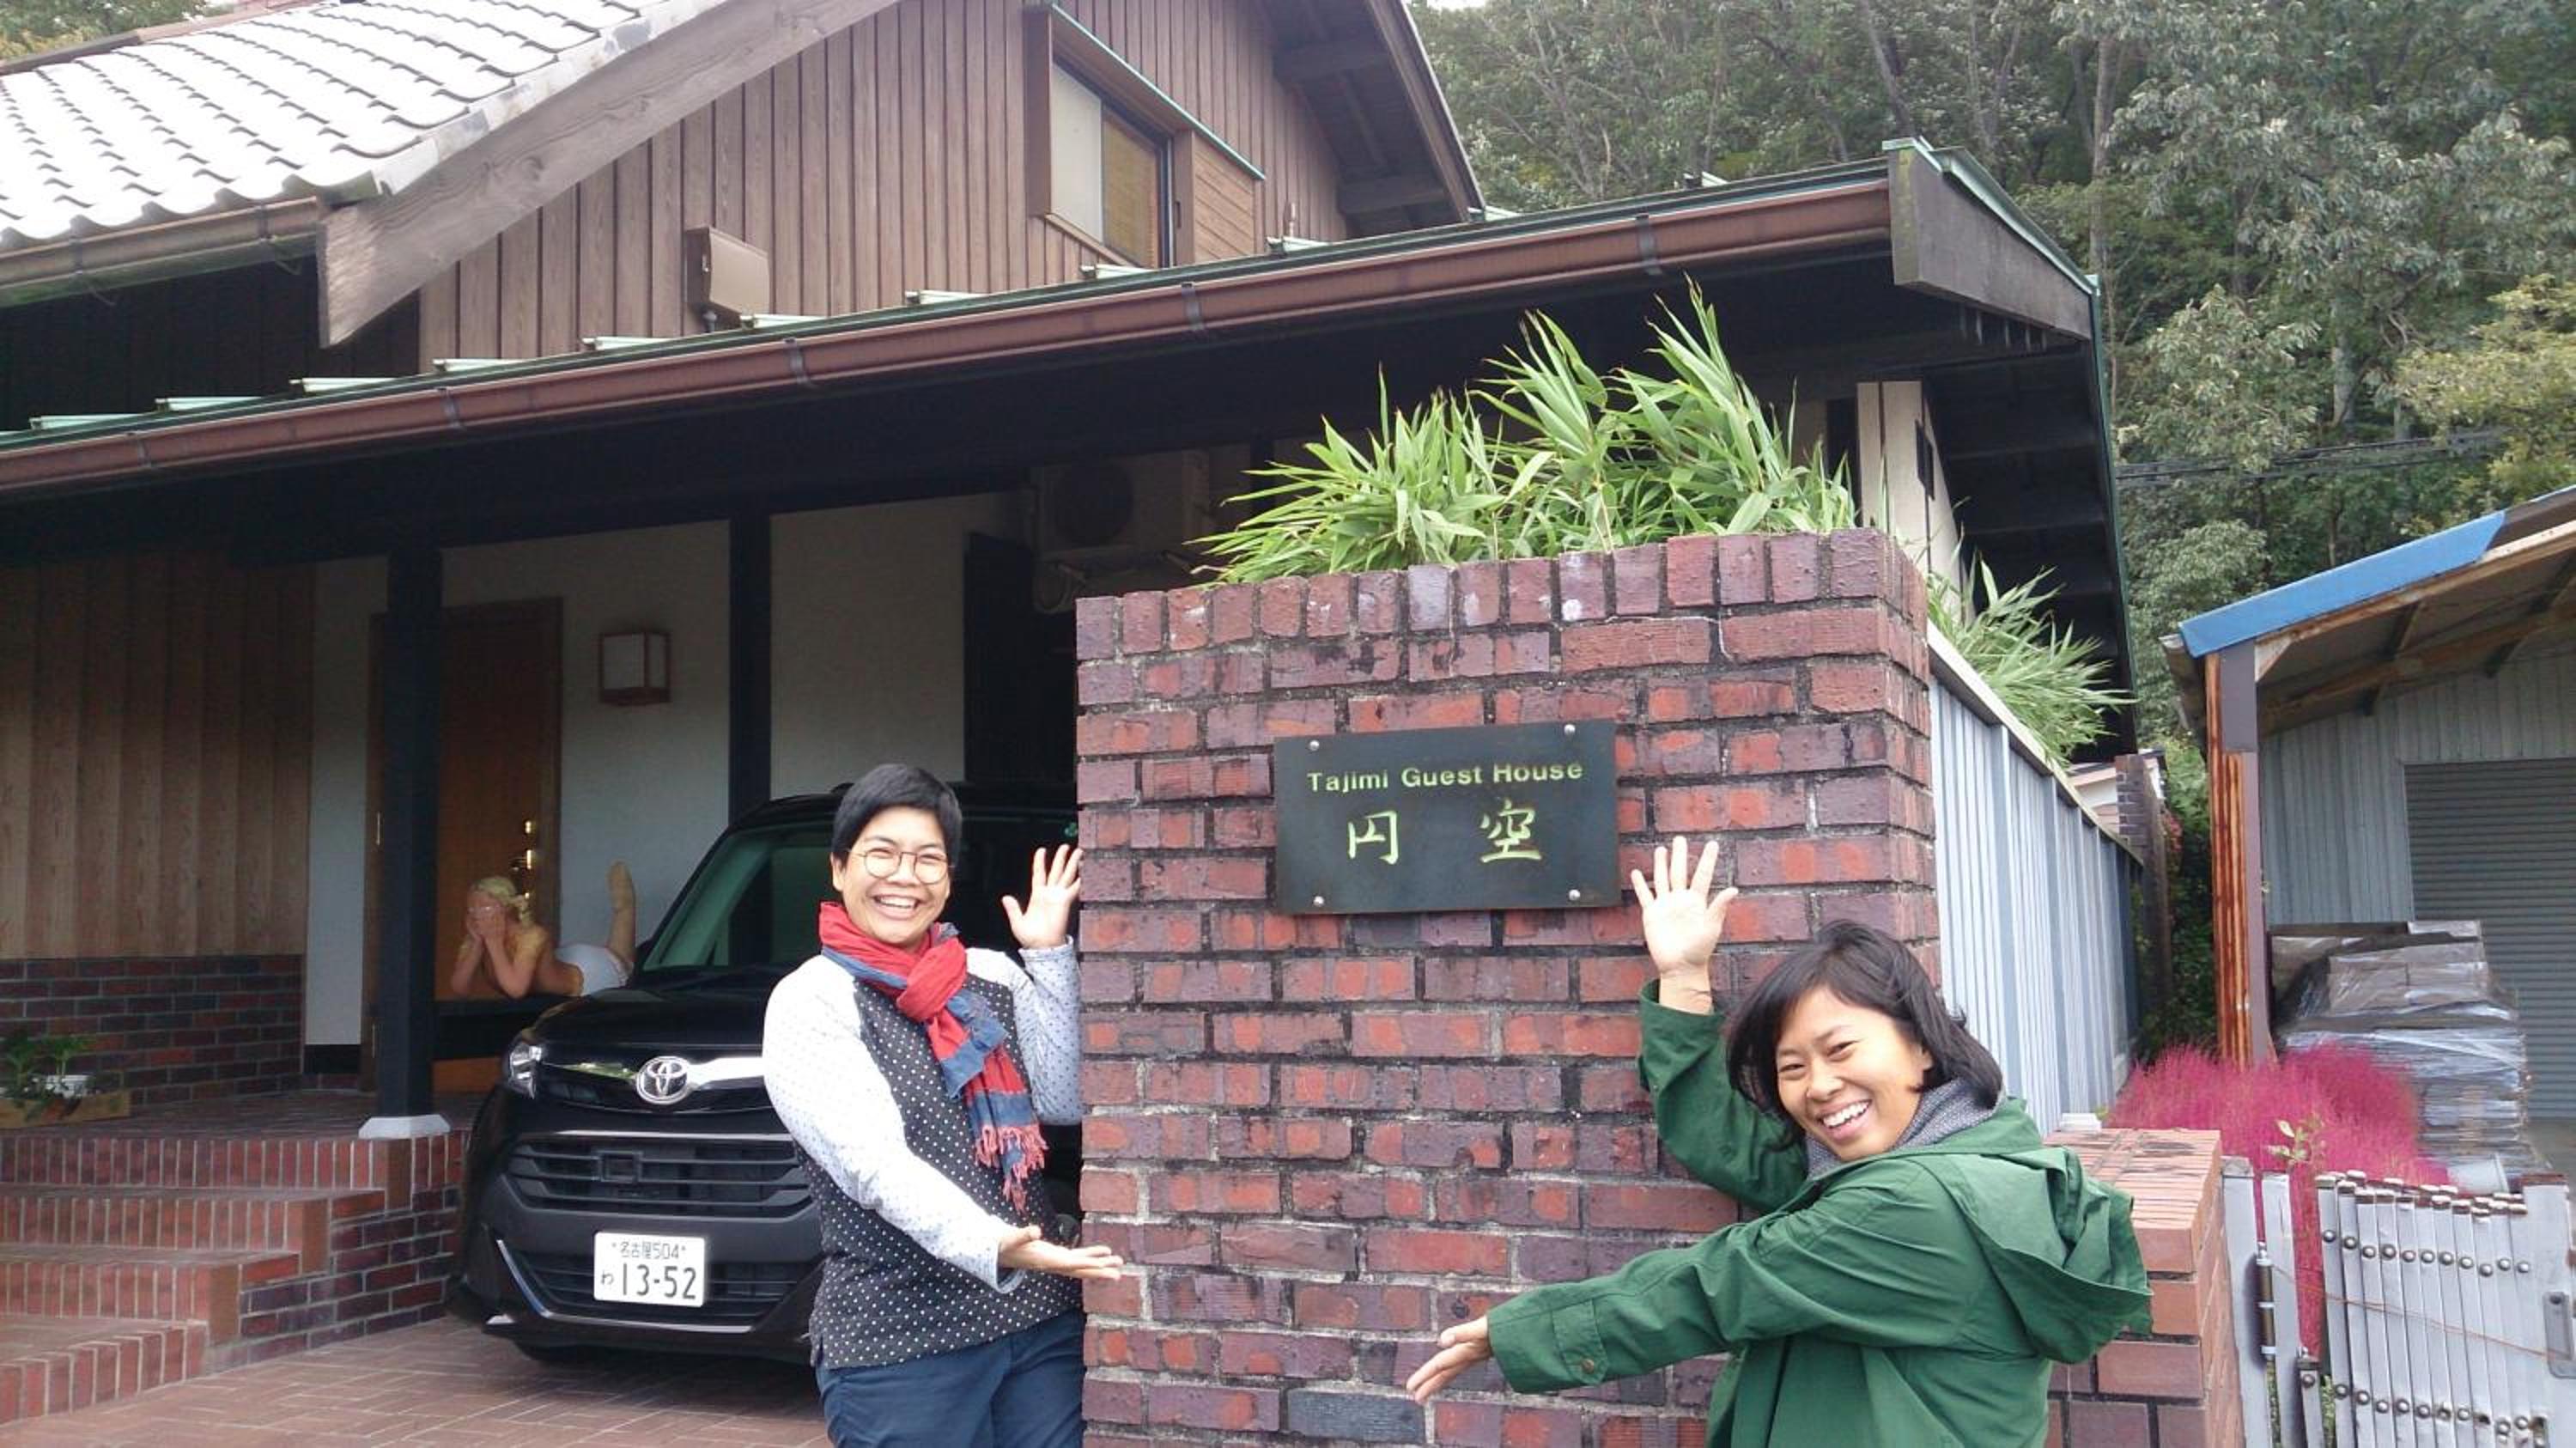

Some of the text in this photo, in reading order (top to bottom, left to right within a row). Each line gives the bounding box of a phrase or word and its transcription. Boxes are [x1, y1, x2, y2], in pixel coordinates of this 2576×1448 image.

[1307, 762, 1584, 794] Tajimi Guest House
[623, 1262, 696, 1299] 13-52
